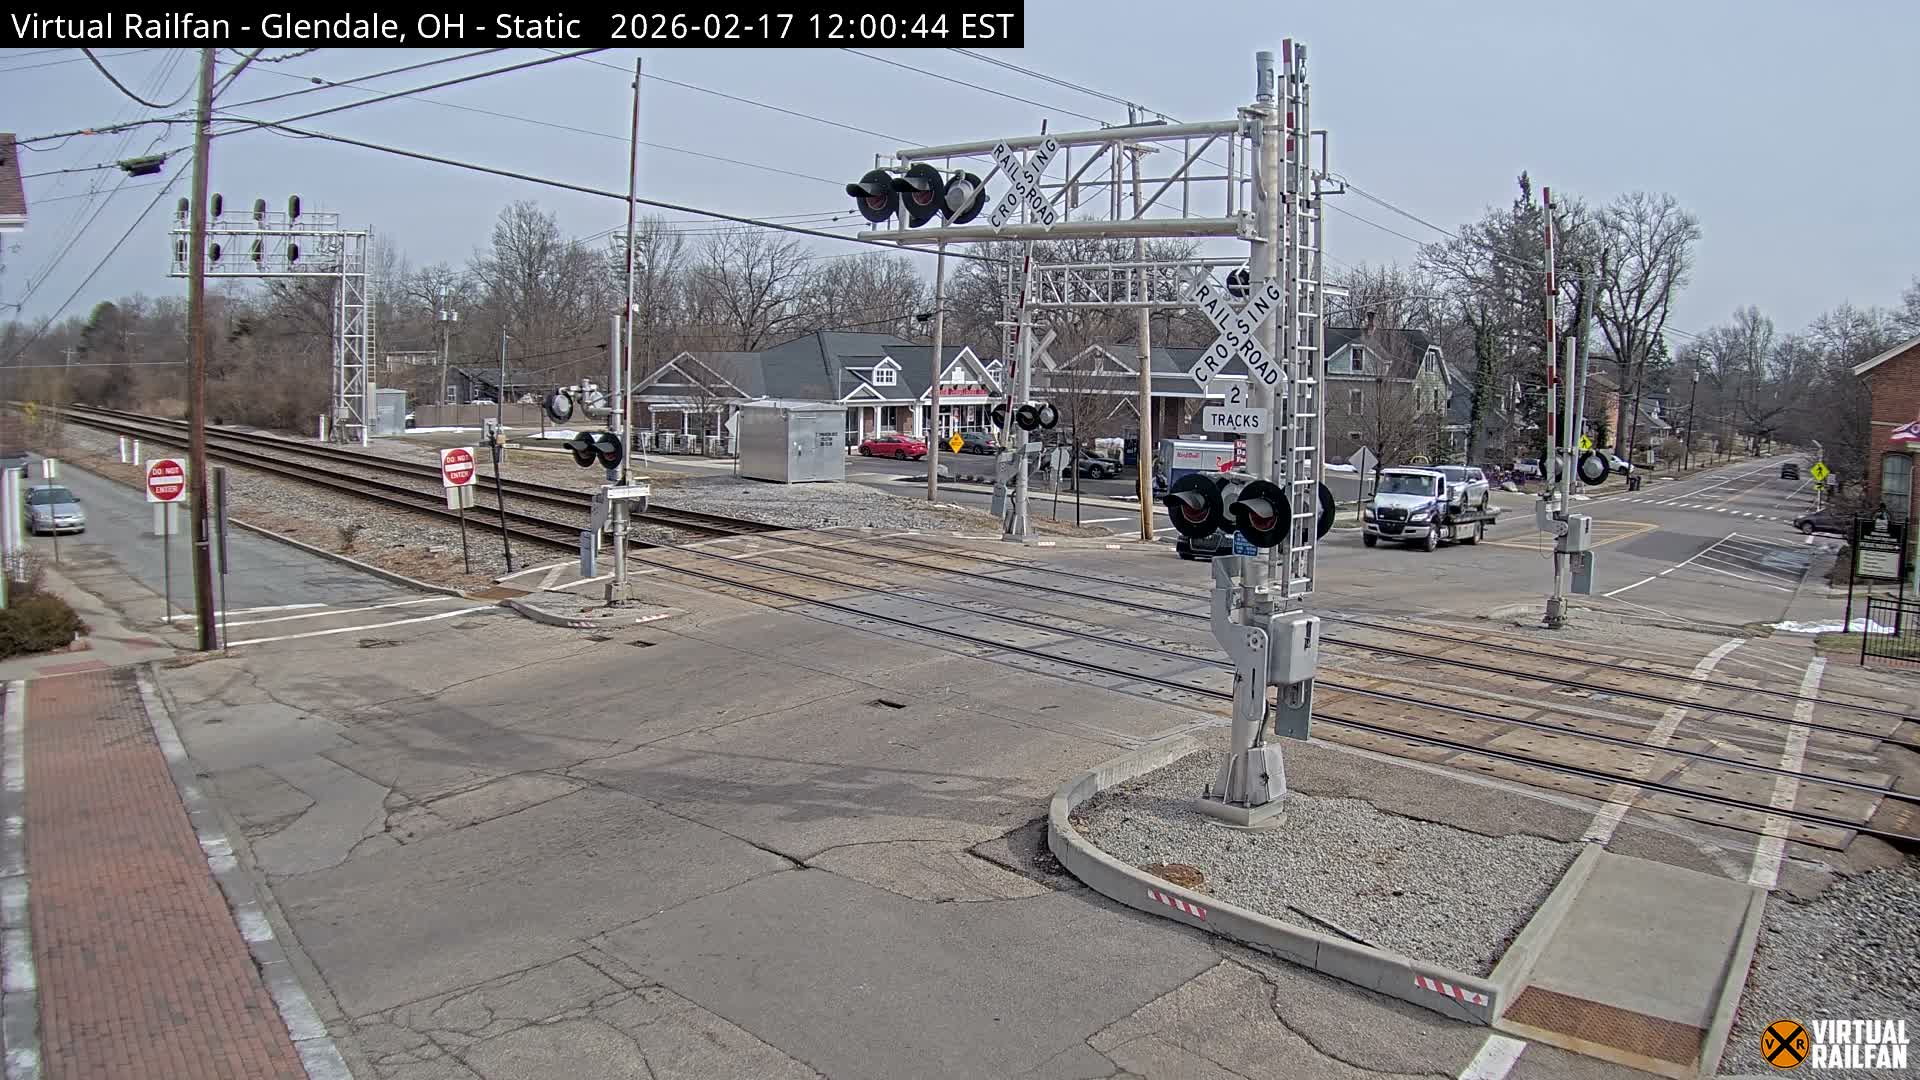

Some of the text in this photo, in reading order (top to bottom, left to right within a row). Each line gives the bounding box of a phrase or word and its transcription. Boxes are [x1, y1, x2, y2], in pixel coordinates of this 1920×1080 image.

[991, 139, 1056, 227] CROSSING
[993, 143, 1055, 226] RAILROAD
[1195, 285, 1280, 382] CROSSING
[1196, 285, 1278, 385] RAILROAD
[1230, 386, 1240, 404] 2
[1211, 413, 1259, 428] TRACKS
[457, 454, 469, 462] NOT
[152, 468, 162, 476] DO
[450, 470, 469, 479] ENTER
